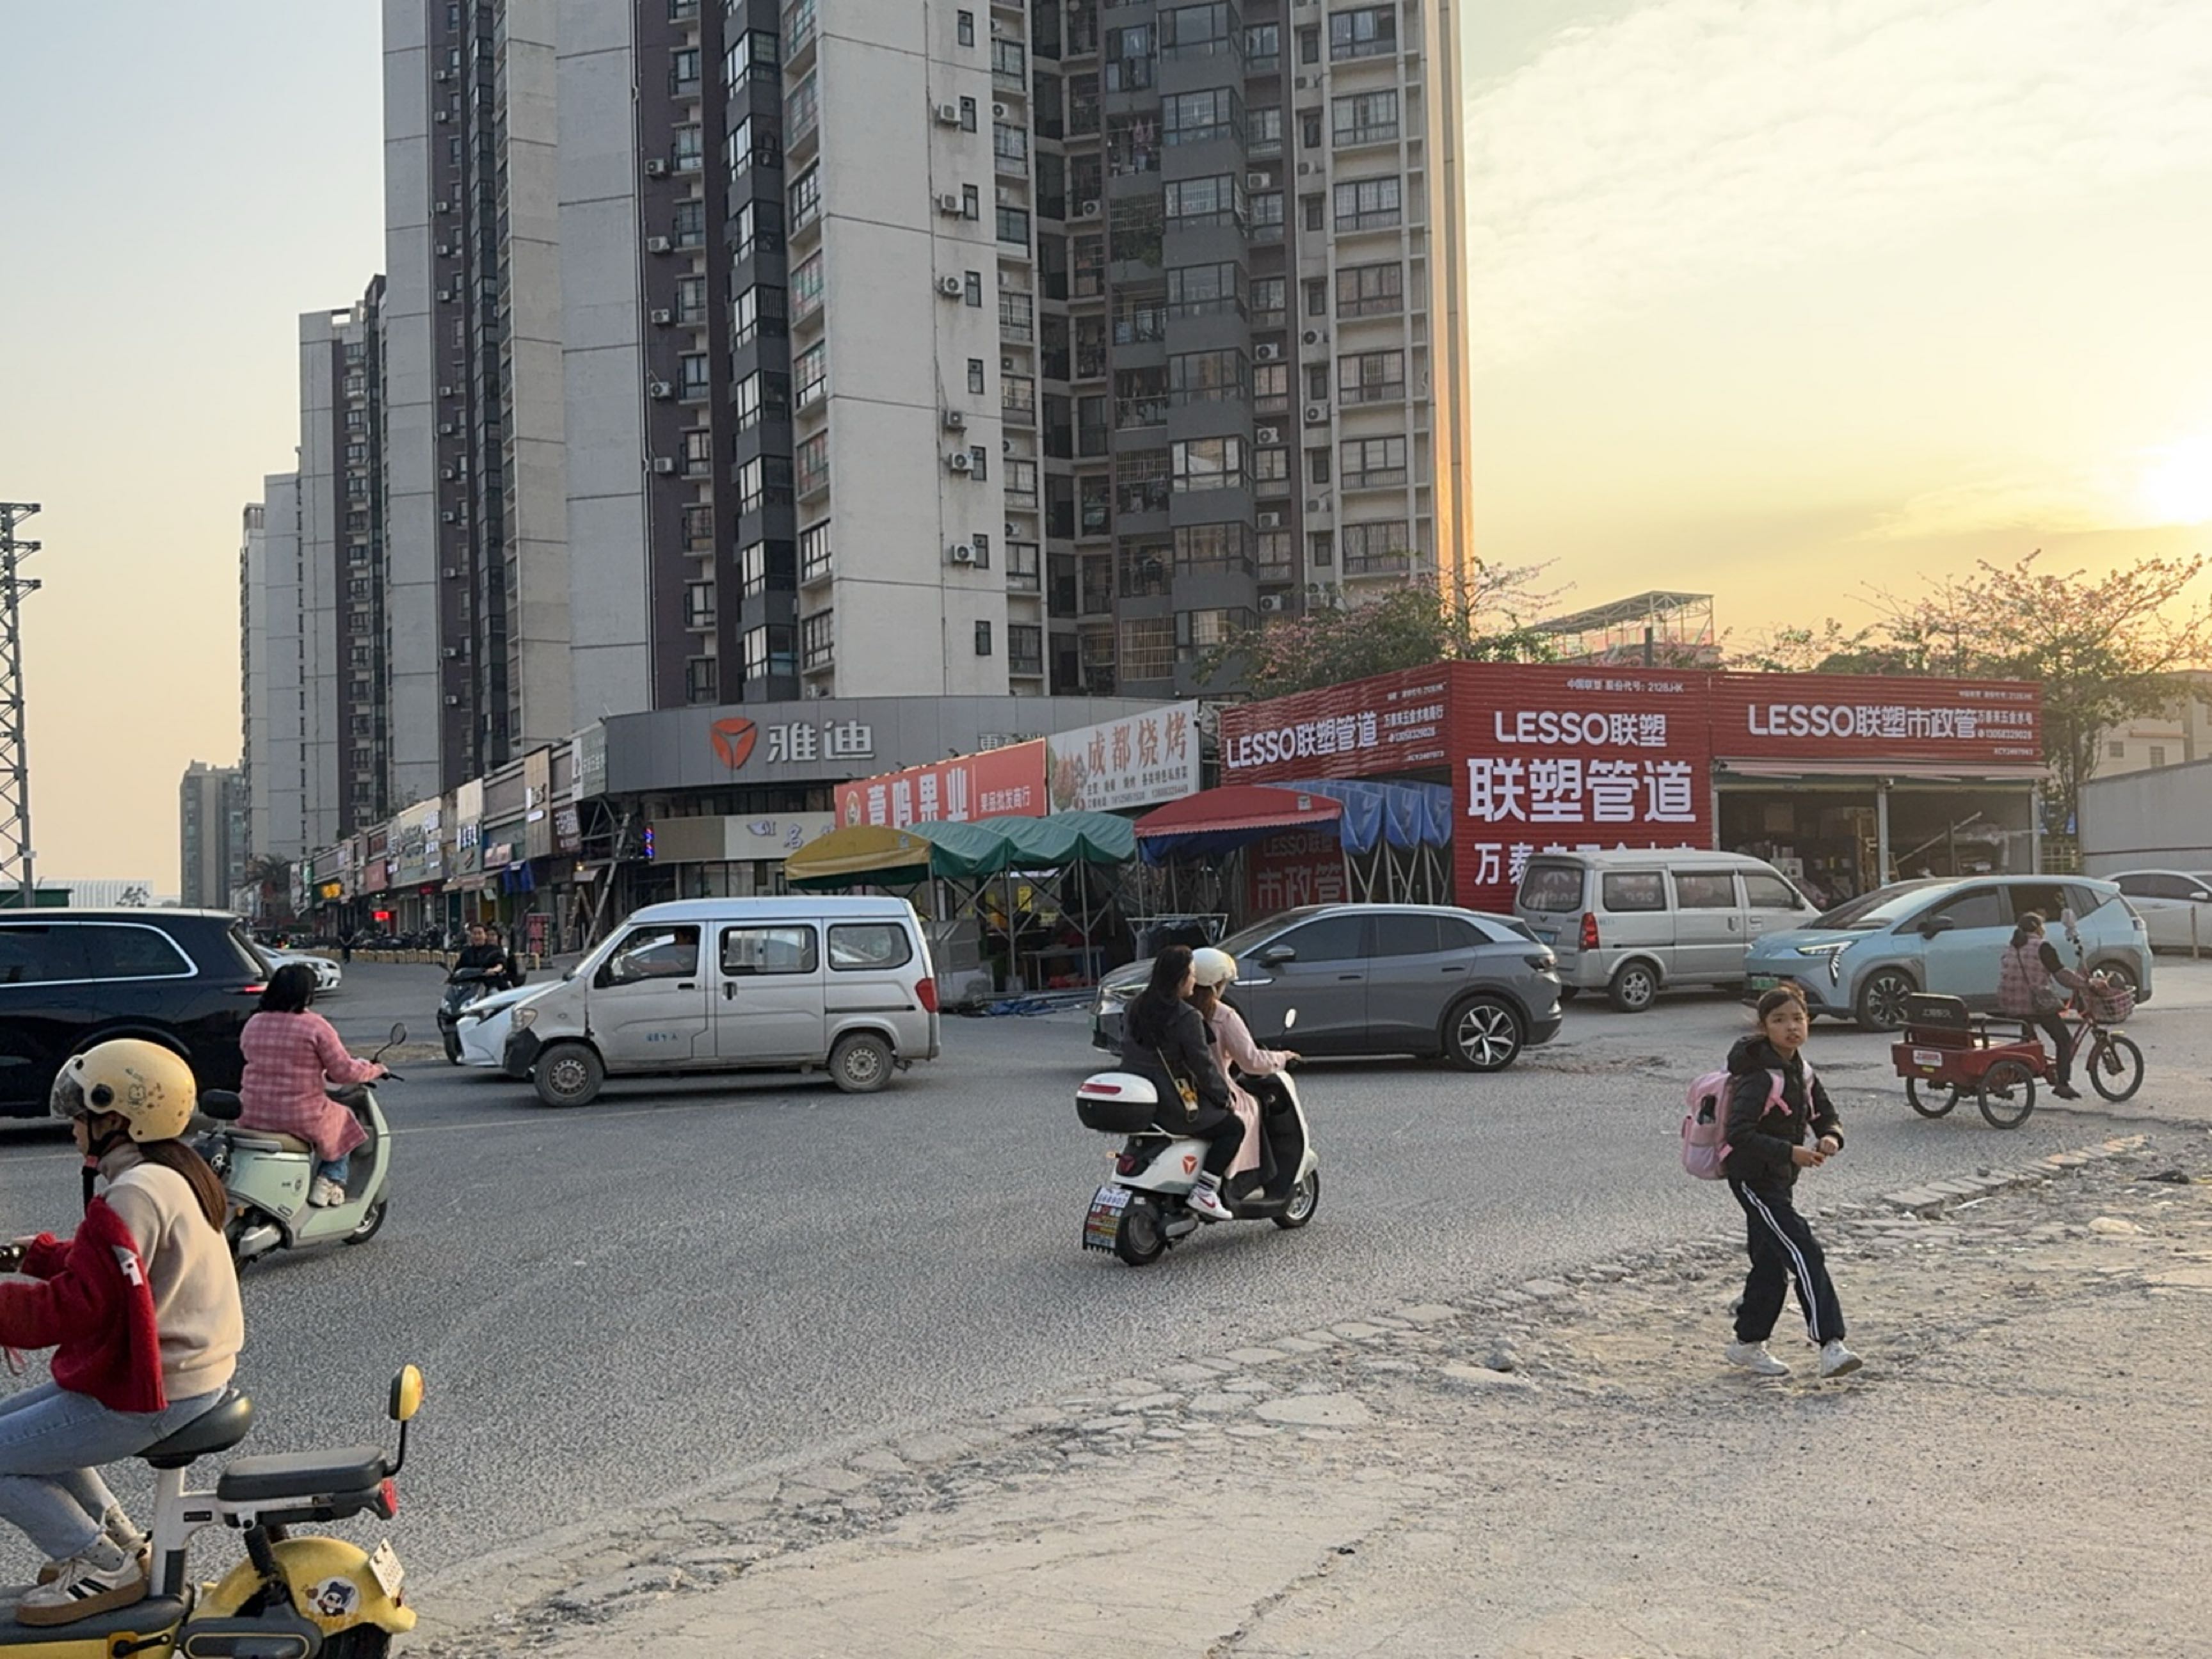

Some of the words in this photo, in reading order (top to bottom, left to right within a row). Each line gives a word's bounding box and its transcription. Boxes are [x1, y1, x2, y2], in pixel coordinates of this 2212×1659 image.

[767, 719, 875, 762] 雅迪
[1225, 711, 1379, 769] LESSO联塑管道
[1494, 710, 1668, 748] LESSO联塑
[1748, 704, 1977, 739] LESSO联塑市政管
[1087, 710, 1187, 777] 成都烧烤
[980, 786, 1030, 812] 果品批发商行
[1466, 757, 1696, 824] 联塑管道
